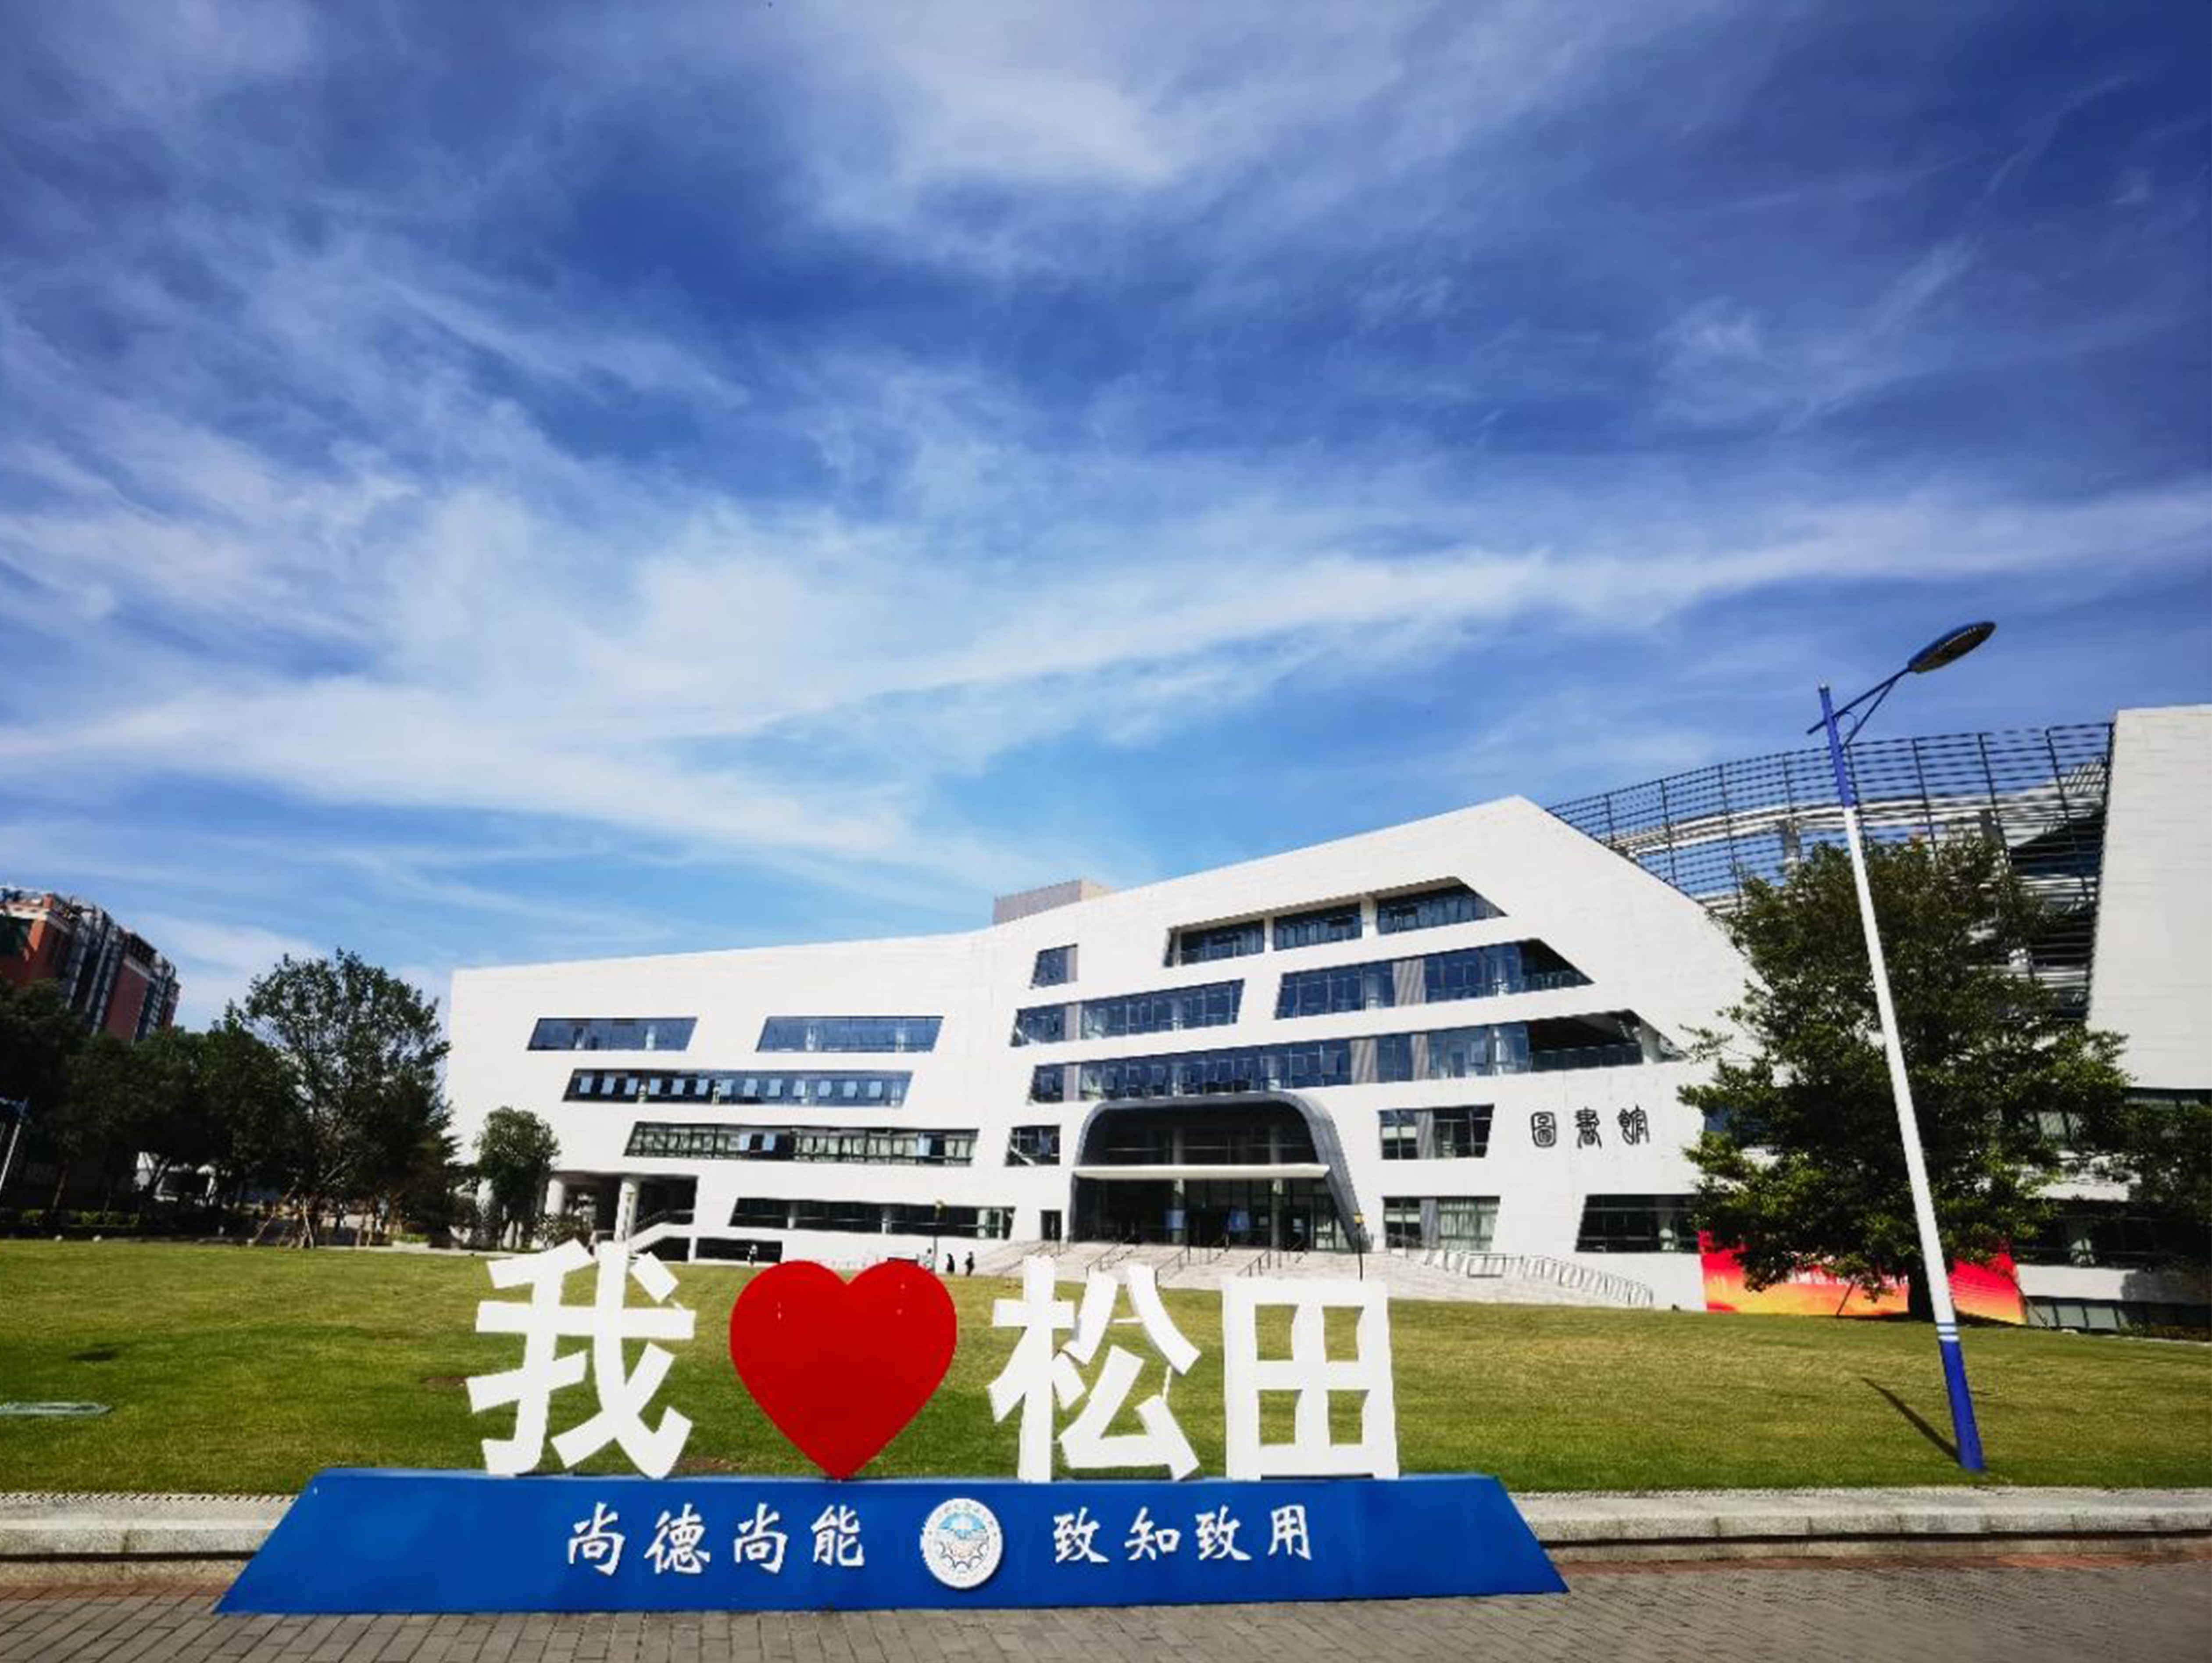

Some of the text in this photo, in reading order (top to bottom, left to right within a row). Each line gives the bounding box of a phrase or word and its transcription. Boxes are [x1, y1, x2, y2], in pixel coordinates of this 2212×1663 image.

[466, 1238, 1399, 1483] 我 松田
[567, 1502, 865, 1576] 尚德尚能
[1053, 1504, 1312, 1563] 致知致用
